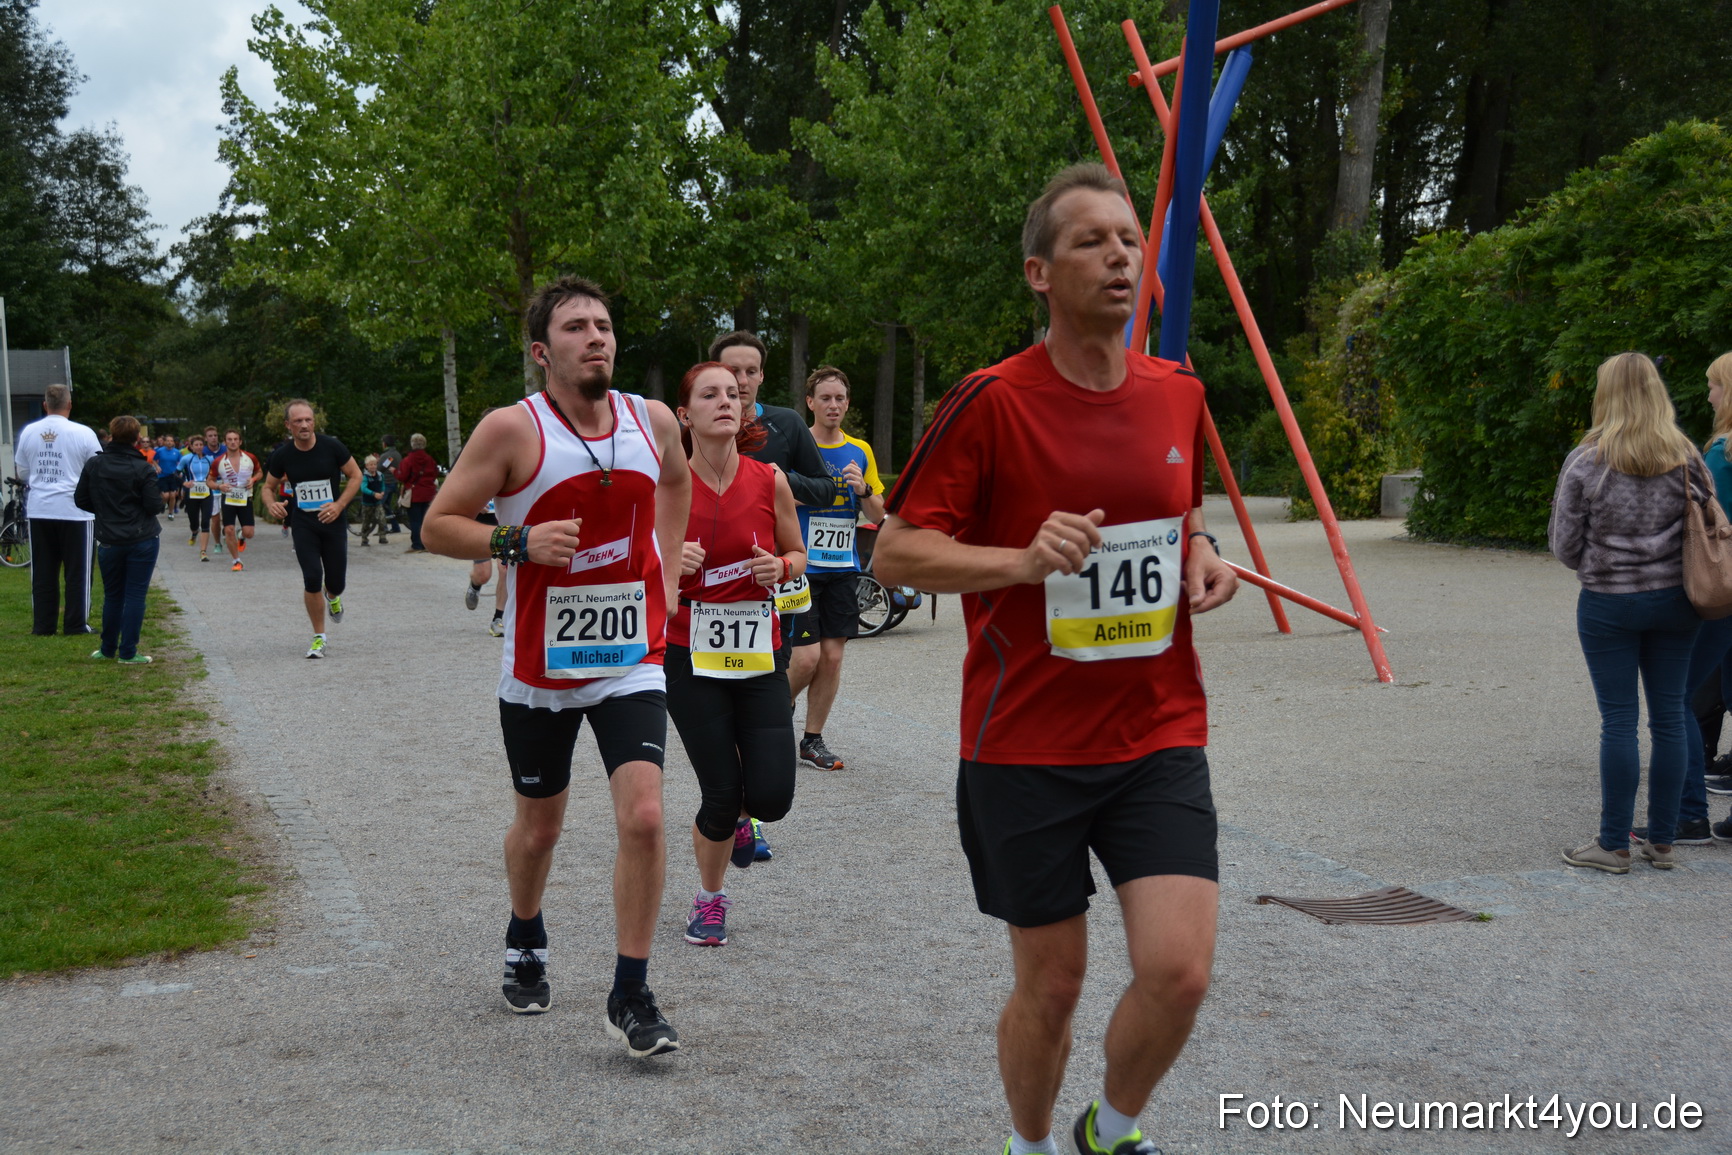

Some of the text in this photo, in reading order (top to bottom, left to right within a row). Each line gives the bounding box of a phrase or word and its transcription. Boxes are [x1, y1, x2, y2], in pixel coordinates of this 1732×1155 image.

[300, 487, 329, 501] 3111
[813, 529, 851, 549] 2701
[1101, 535, 1163, 553] Neumarkt
[587, 548, 615, 564] DEHN
[717, 566, 740, 580] DEHN
[1079, 555, 1163, 610] 146
[549, 592, 631, 605] PARTL Neumarkt
[693, 608, 760, 616] PARTL Neumarkt
[556, 605, 638, 642] 2200
[1093, 620, 1152, 642] Achim
[708, 620, 759, 649] 317
[571, 650, 624, 665] Michael
[724, 656, 744, 668] Eva
